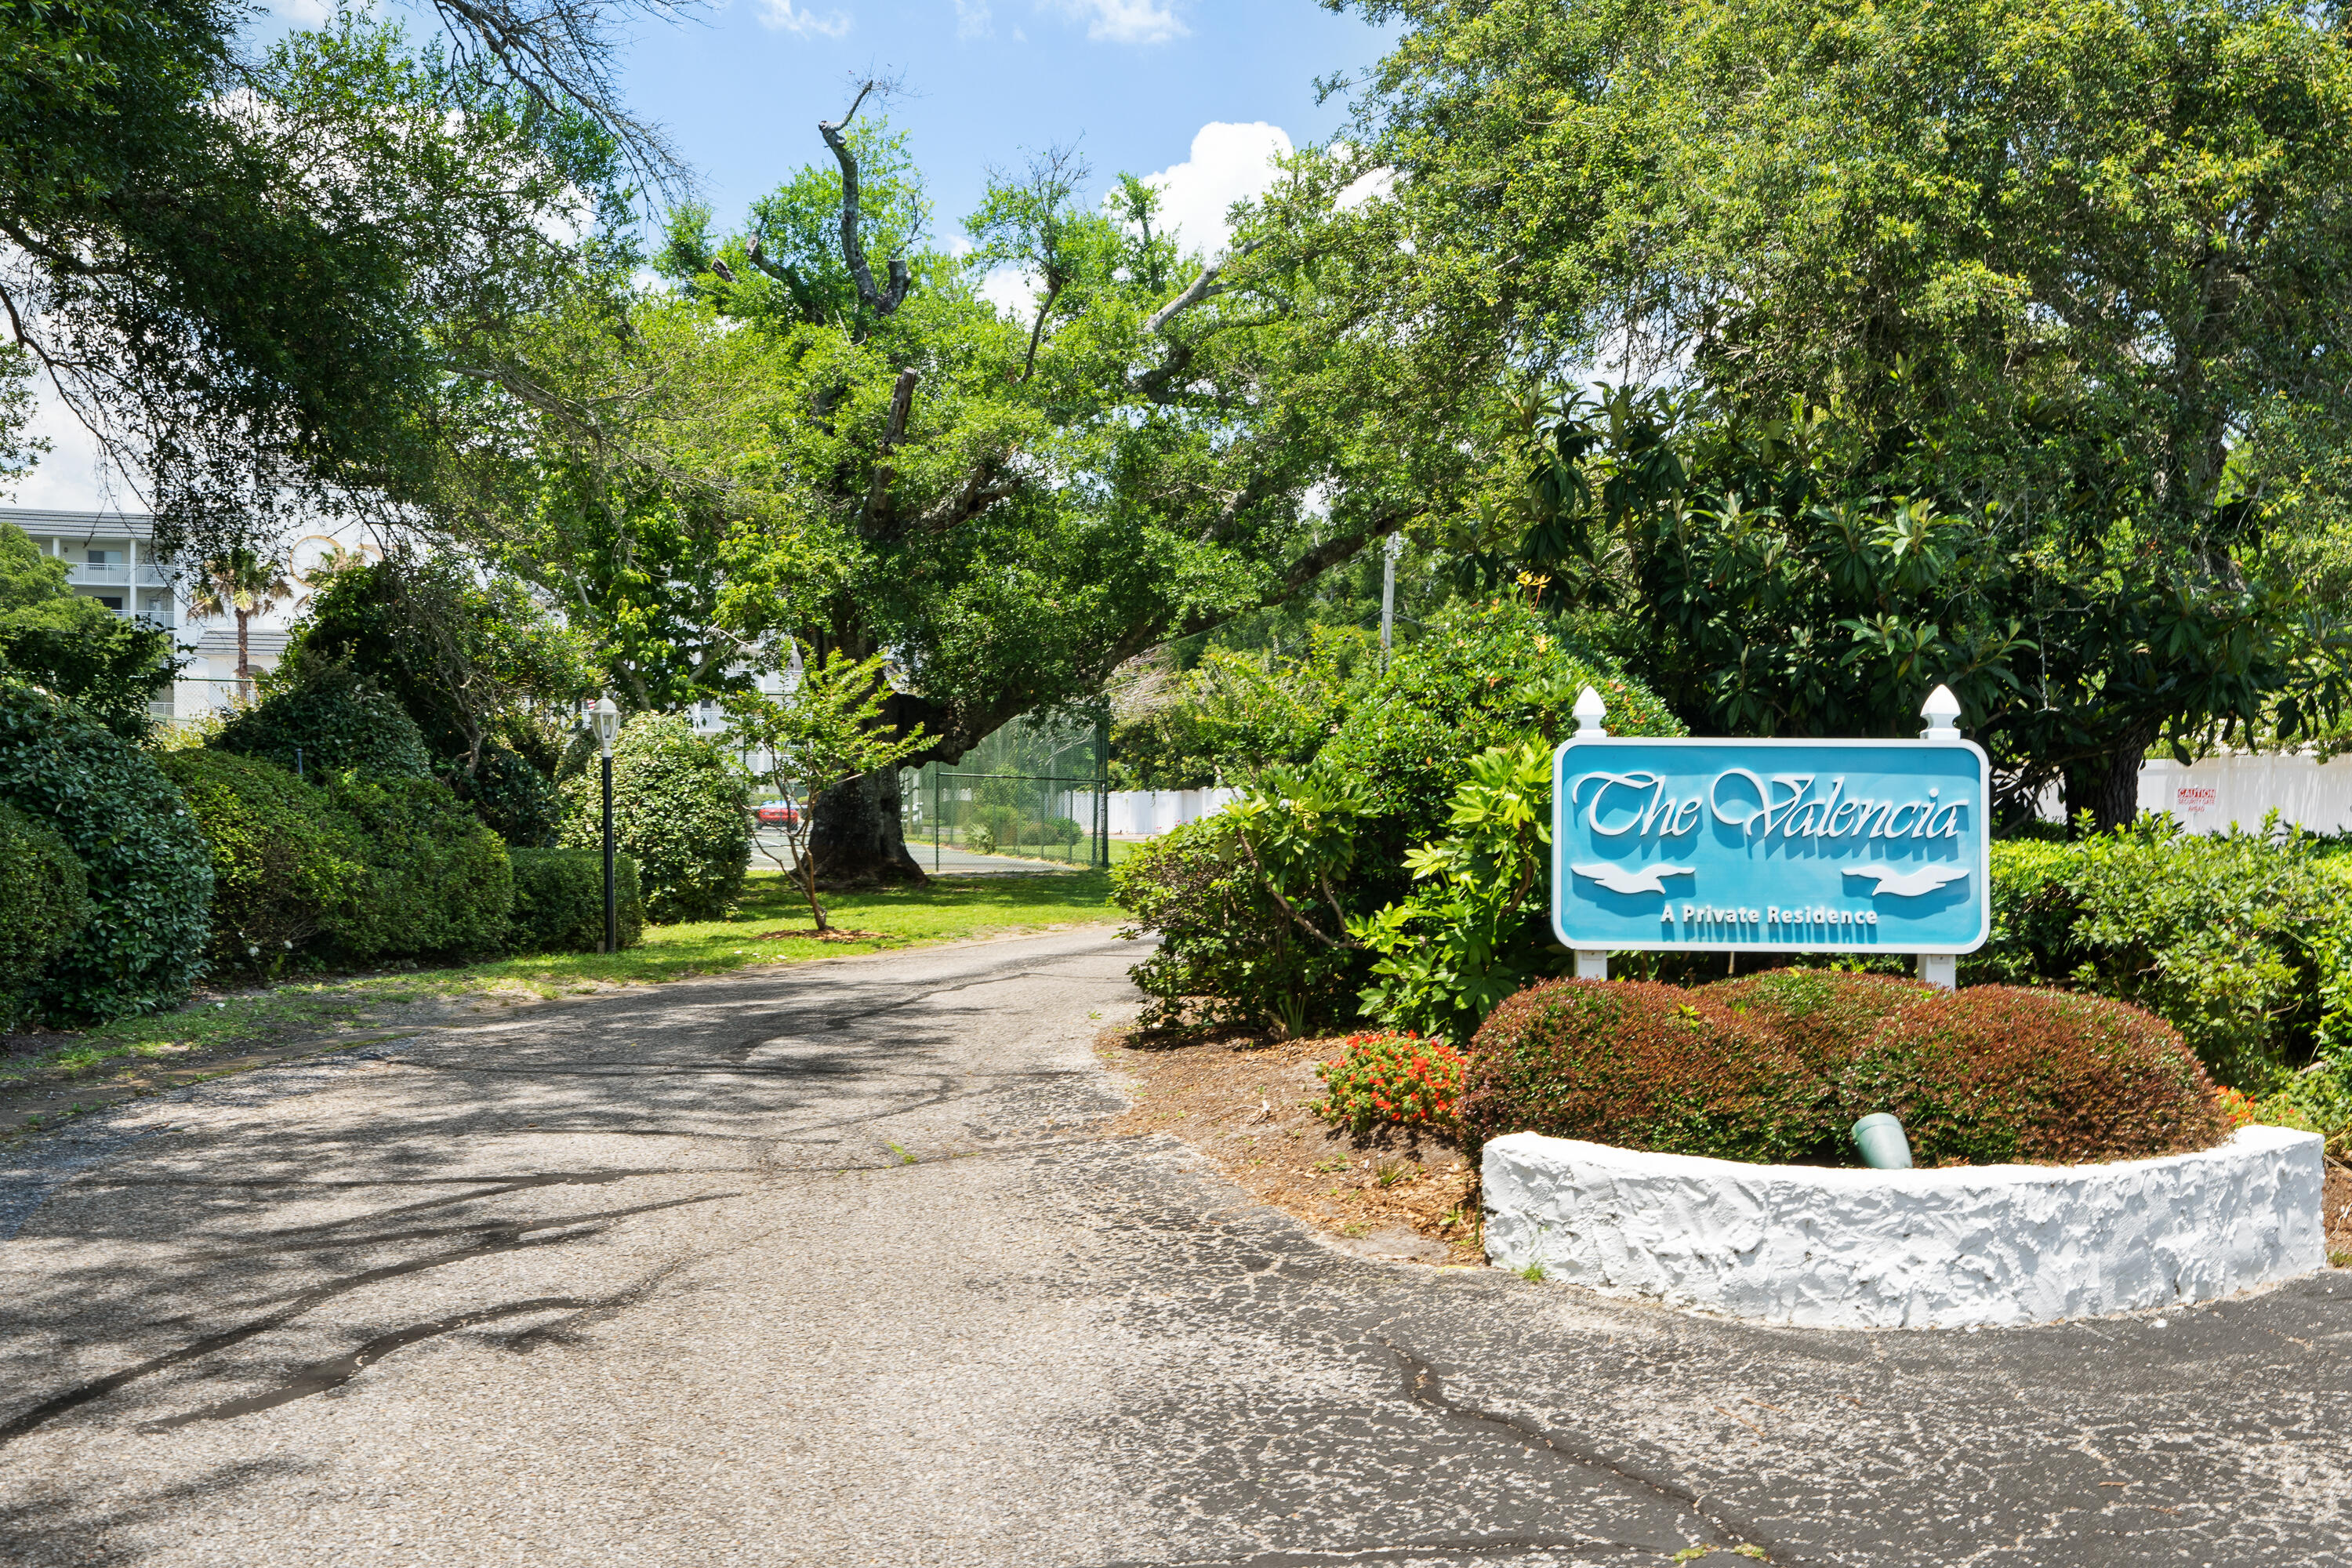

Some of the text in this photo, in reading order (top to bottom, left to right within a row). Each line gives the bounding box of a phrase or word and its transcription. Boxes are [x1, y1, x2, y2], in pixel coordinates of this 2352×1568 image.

[1572, 768, 1969, 840] The Valencia
[1661, 904, 1878, 924] A Private Residence
